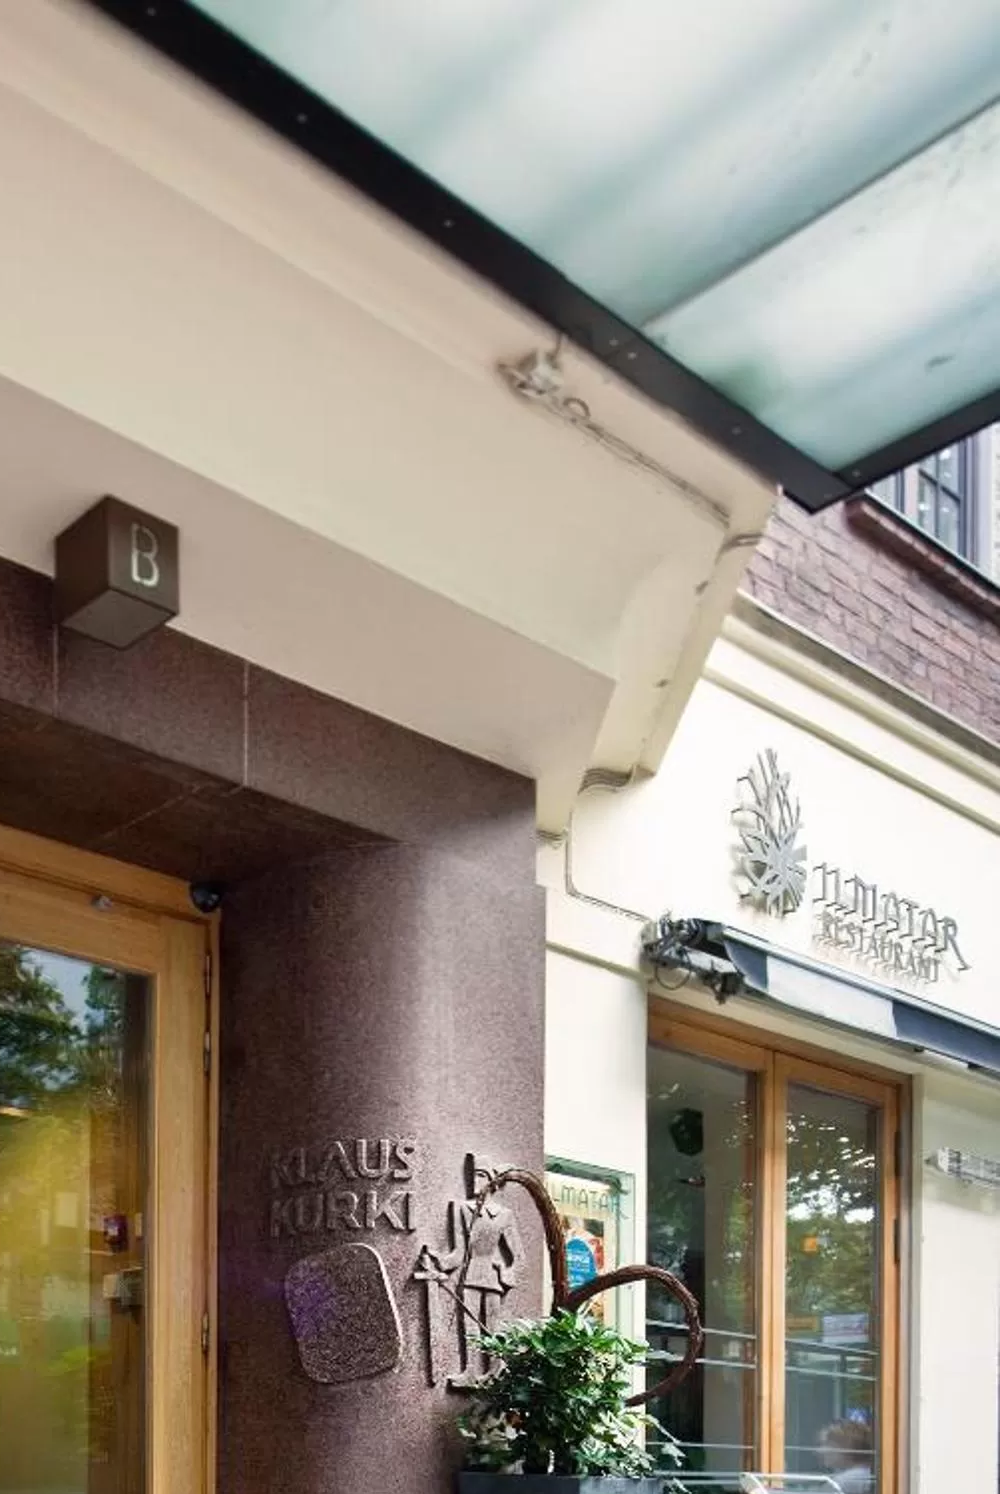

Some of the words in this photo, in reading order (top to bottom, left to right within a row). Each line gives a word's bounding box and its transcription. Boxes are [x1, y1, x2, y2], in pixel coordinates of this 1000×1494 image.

[131, 522, 160, 587] B
[812, 862, 973, 972] ILMATAR
[813, 909, 942, 984] RESTAURANT
[269, 1134, 418, 1189] KLAUS
[269, 1189, 418, 1238] KURKI
